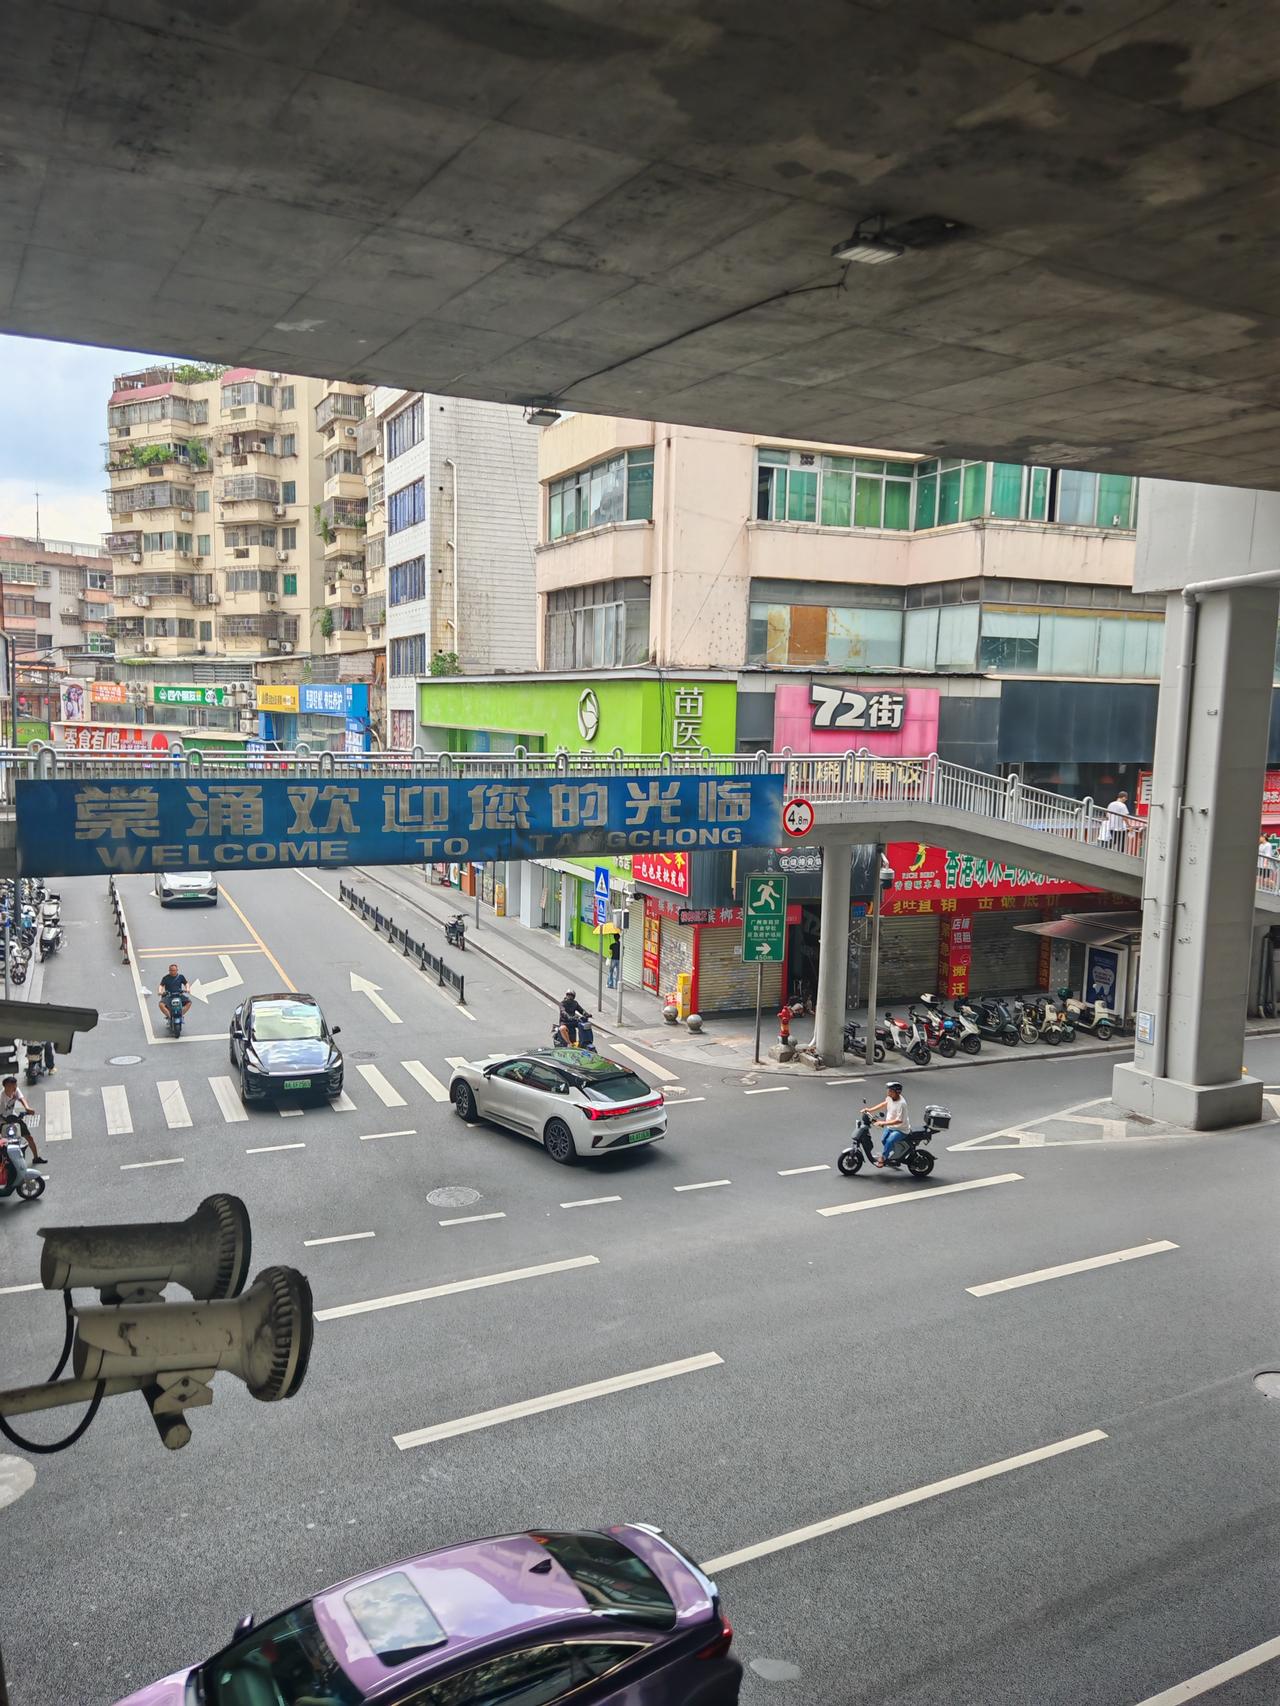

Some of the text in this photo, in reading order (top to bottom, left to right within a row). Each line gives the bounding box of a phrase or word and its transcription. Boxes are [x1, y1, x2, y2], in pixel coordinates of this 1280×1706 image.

[812, 684, 904, 728] 72街
[74, 781, 752, 840] 棠涌欢迎您的光临
[788, 810, 809, 826] 4.8m
[97, 840, 349, 869] WELCOME
[415, 838, 470, 858] TO
